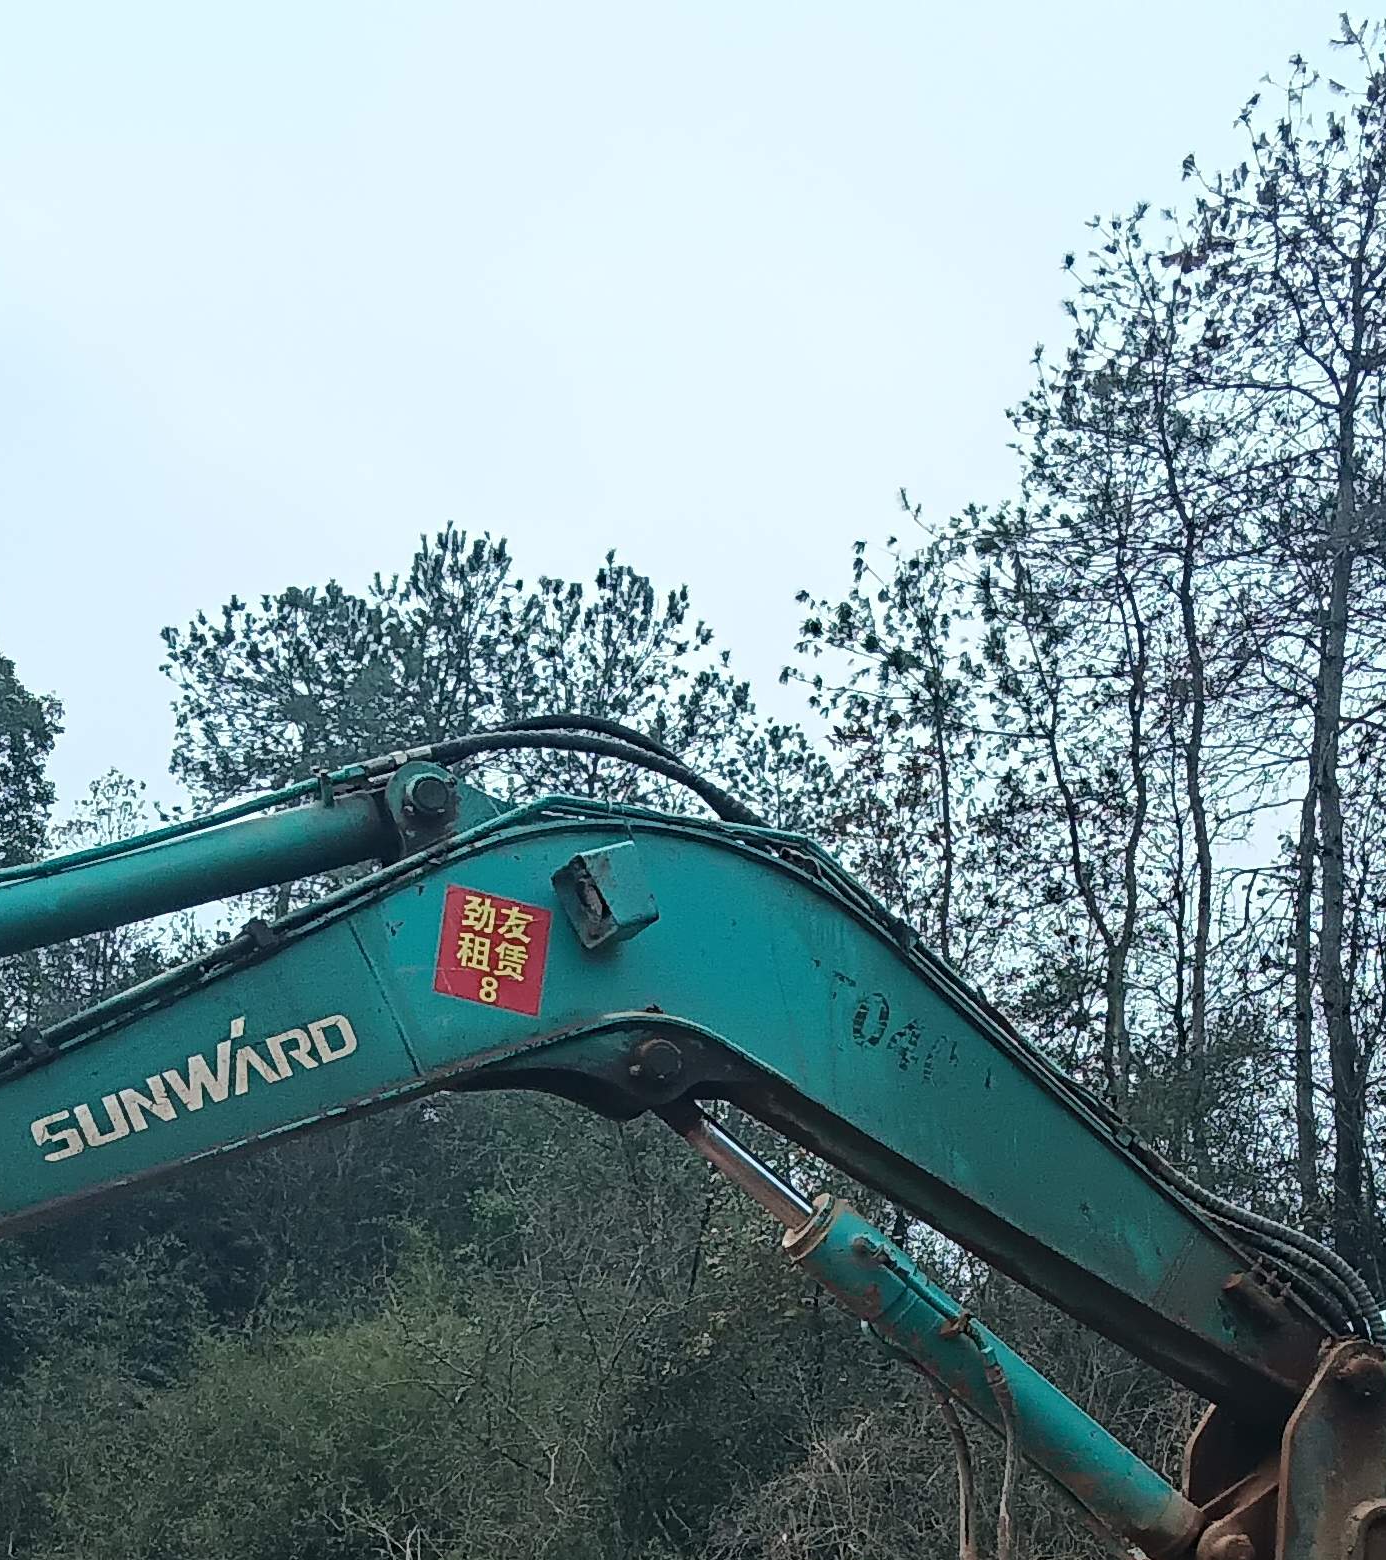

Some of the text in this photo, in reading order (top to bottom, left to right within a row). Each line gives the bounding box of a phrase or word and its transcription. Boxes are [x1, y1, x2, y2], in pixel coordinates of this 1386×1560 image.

[461, 895, 534, 943] 劲友
[456, 932, 529, 981] 租赁
[479, 976, 498, 1002] 8
[30, 1015, 358, 1162] SUNWARD
